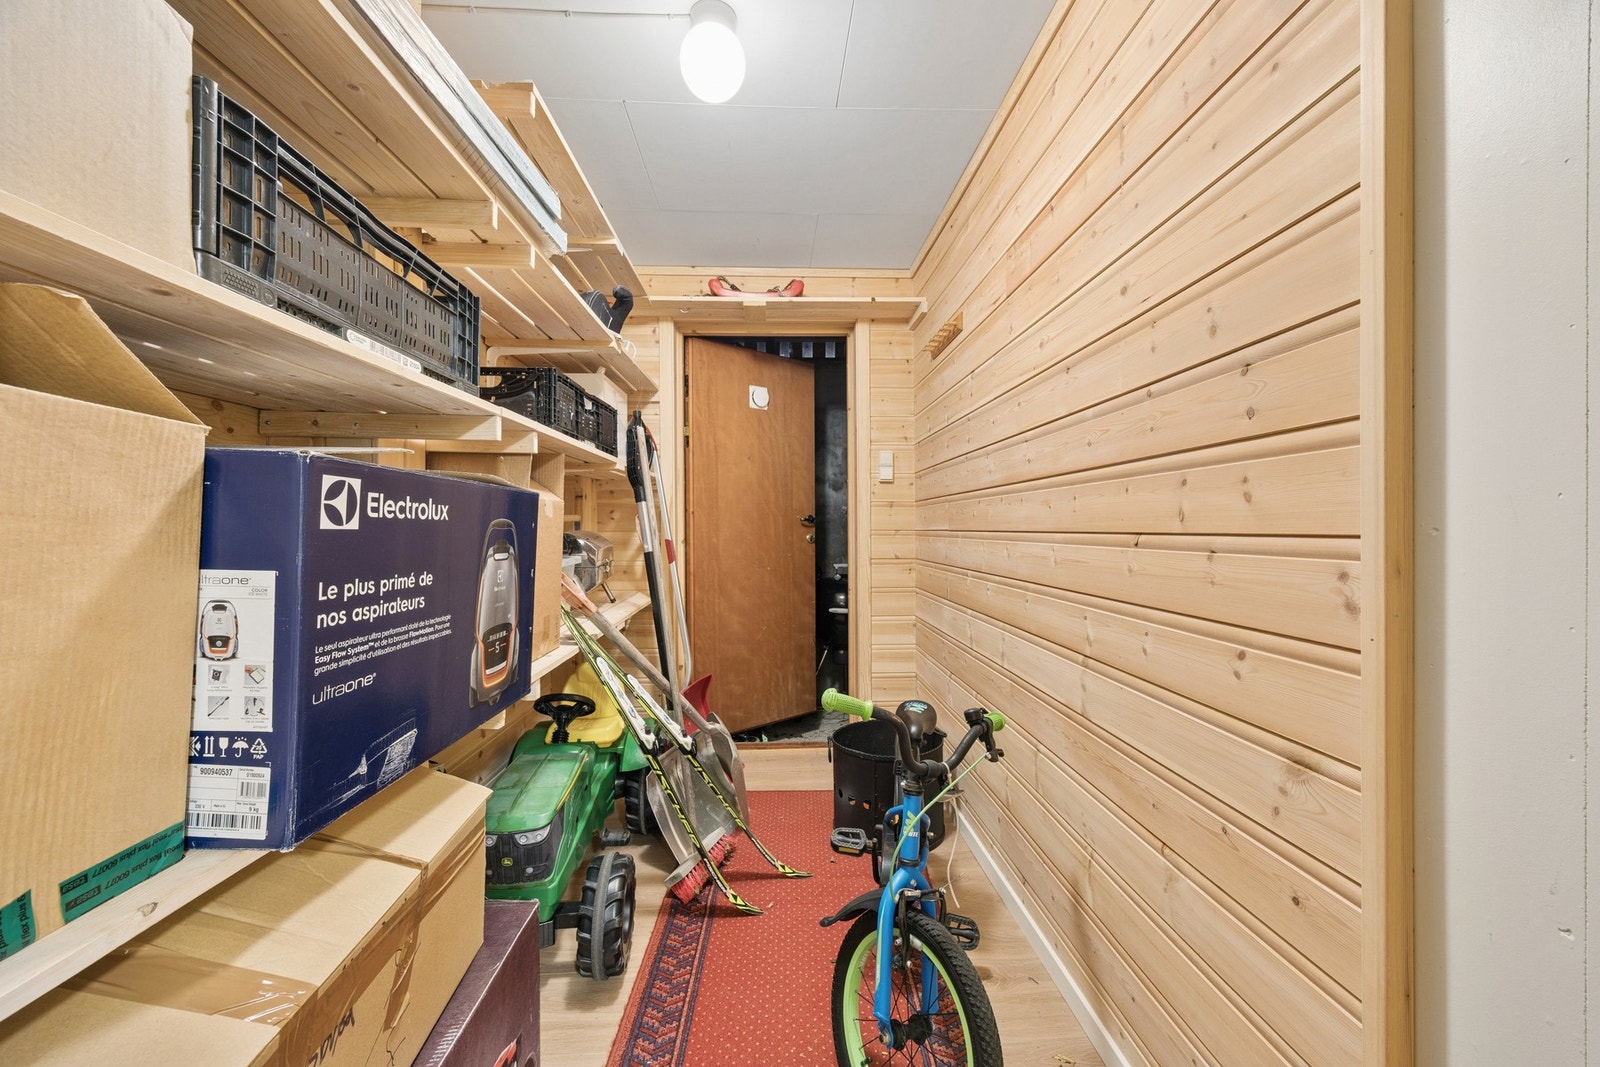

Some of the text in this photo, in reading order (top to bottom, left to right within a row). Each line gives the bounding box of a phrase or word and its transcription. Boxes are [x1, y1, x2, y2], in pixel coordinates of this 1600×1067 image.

[367, 492, 449, 520] Electrolux
[199, 575, 249, 585] ltraone
[318, 572, 434, 602] Le plus primé de
[316, 596, 426, 629] nos aspirateurs
[315, 646, 323, 654] Le
[324, 641, 338, 652] seul
[338, 635, 368, 648] aspirateur
[369, 632, 382, 641] ultra
[382, 625, 408, 638] performant
[429, 614, 452, 625] technologie
[314, 653, 332, 665] Easy
[332, 650, 346, 660] Flow
[381, 638, 387, 646] de
[393, 633, 408, 643] brosse
[435, 623, 444, 631] Pour
[314, 662, 338, 677] grande
[338, 654, 366, 668] simplicité
[367, 645, 396, 660] d'utilisation
[402, 640, 410, 649] des
[411, 634, 428, 646] résultats
[200, 768, 232, 776] 900940537
[644, 754, 700, 848] FISCHER
[684, 755, 746, 830] FISCHER
[120, 847, 136, 861] plus
[137, 842, 152, 856] flex
[148, 852, 162, 864] flex
[91, 860, 118, 878] 60077
[132, 858, 148, 872] plus
[61, 875, 86, 892] tesa
[105, 870, 130, 889] 60077
[18, 903, 30, 922] plus
[20, 922, 30, 938] flex
